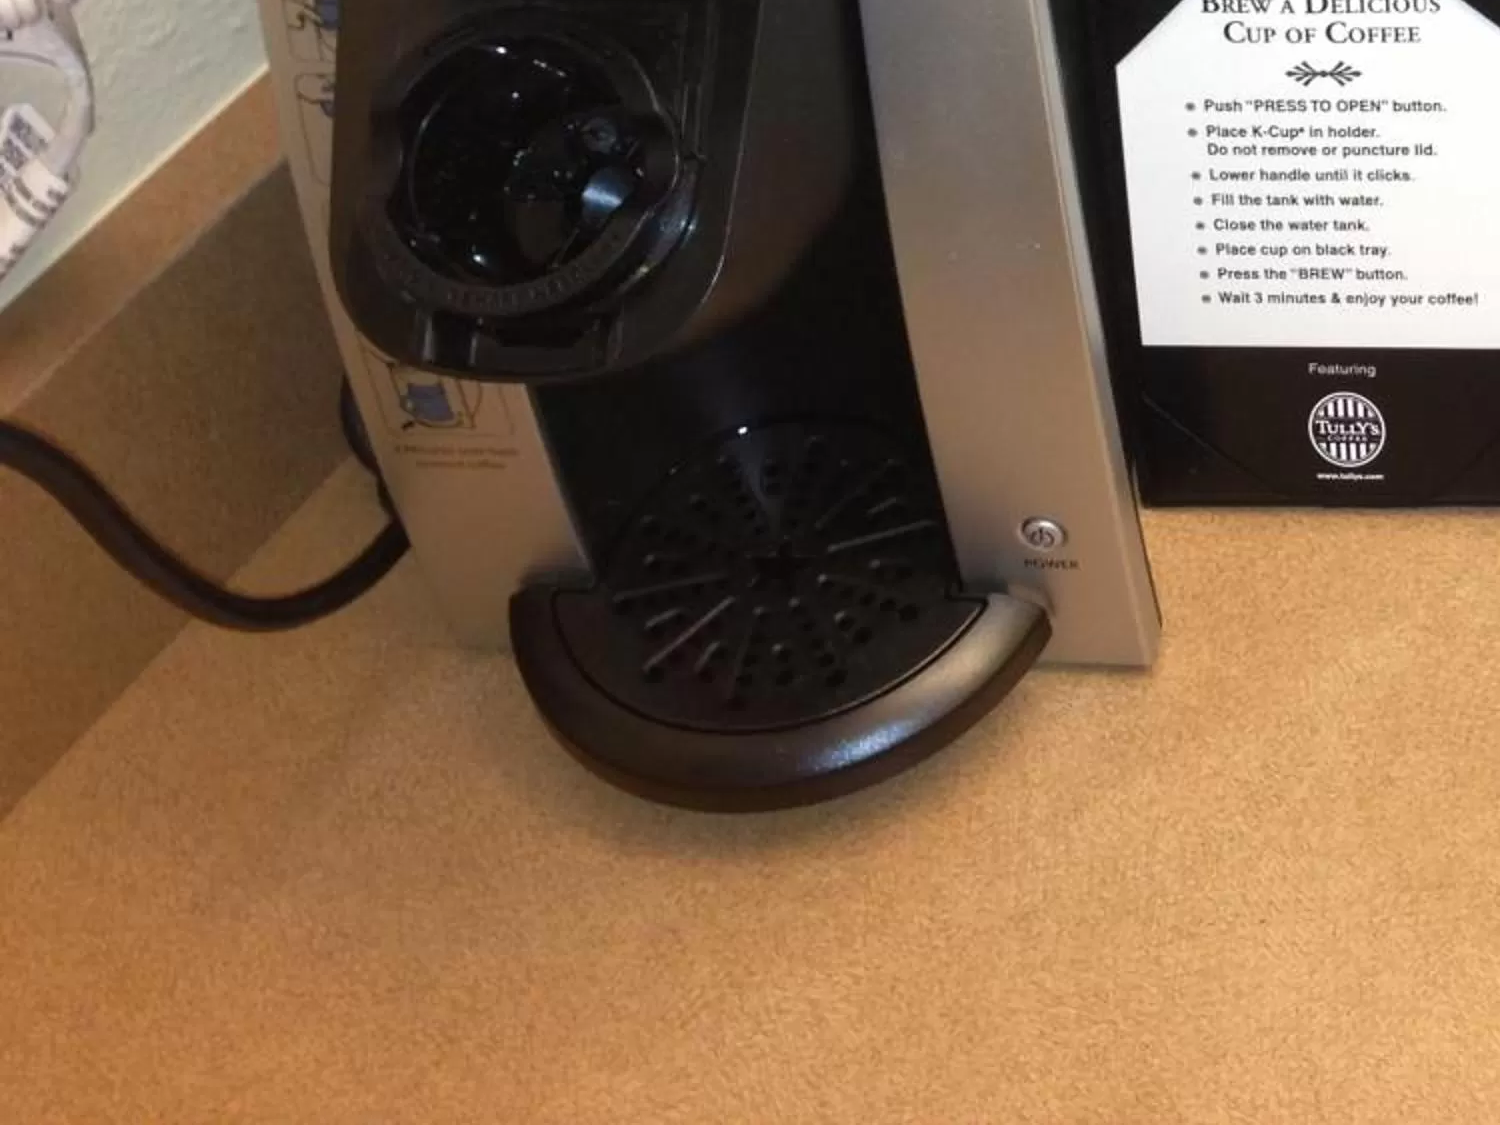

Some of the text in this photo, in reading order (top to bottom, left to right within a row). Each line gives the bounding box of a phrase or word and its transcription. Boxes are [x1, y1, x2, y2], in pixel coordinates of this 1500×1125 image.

[1223, 21, 1421, 44] CUP OF COFFEE
[1204, 99, 1242, 112] Push
[1311, 100, 1331, 112] TO
[1392, 99, 1447, 113] button.
[1206, 125, 1247, 138] Place
[1309, 126, 1323, 138] in
[1327, 126, 1380, 138] holder.
[1207, 144, 1438, 159] Do not remove or puncture lid.
[1209, 169, 1415, 181] Lower handle until it clicks.
[1211, 193, 1384, 207] Fill the tank with water.
[1213, 219, 1370, 231] Close the water tank.
[1216, 243, 1392, 259] Place cup on black tray.
[1217, 268, 1408, 280] Press the "BREW" button.
[1218, 292, 1479, 307] Wait 3 minutes & enjoy your coffee!
[1308, 362, 1377, 377] Featuring
[1315, 420, 1380, 436] TULLY'S
